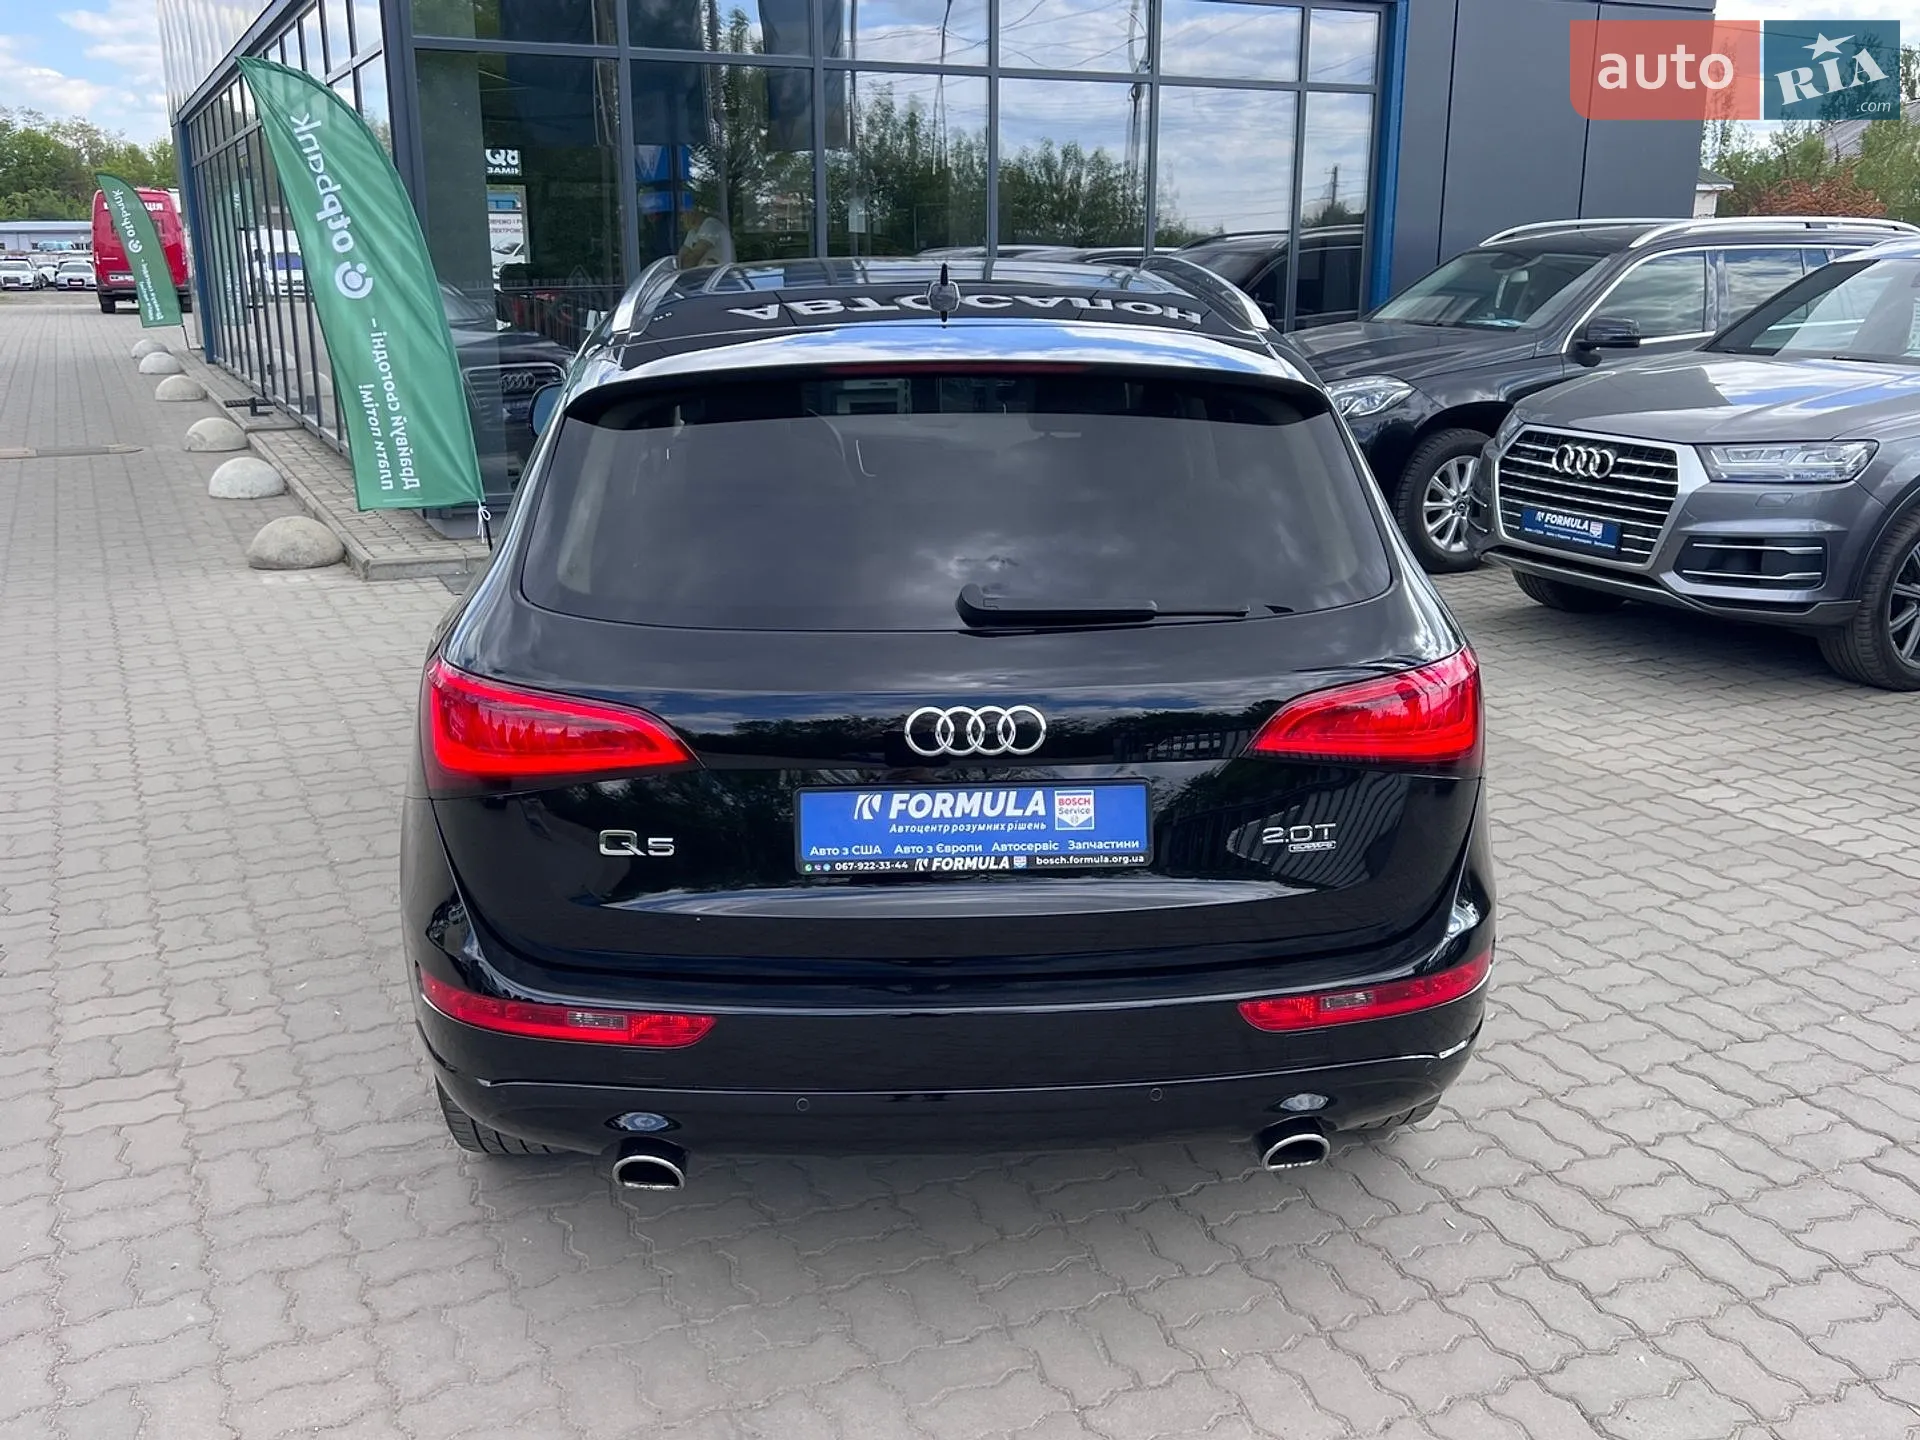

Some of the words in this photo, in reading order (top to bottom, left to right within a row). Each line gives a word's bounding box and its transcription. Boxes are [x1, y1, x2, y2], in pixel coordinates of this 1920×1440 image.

[1544, 513, 1589, 531] FORMULA
[888, 791, 1046, 819] FORMULA
[1058, 797, 1091, 806] BOSCH
[1058, 807, 1091, 815] Service
[1006, 821, 1047, 832] рішень
[600, 829, 675, 856] Q5
[810, 846, 840, 856] Авто
[851, 844, 882, 855] США
[894, 843, 924, 854] Авто
[935, 842, 983, 854] Європи
[992, 840, 1059, 853] Автосервіс
[1068, 839, 1140, 851] Запчастини
[834, 861, 909, 872] 067-922-33-44
[932, 856, 1010, 870] FORMULA
[1036, 854, 1145, 866] bosch.formula.org.ua
